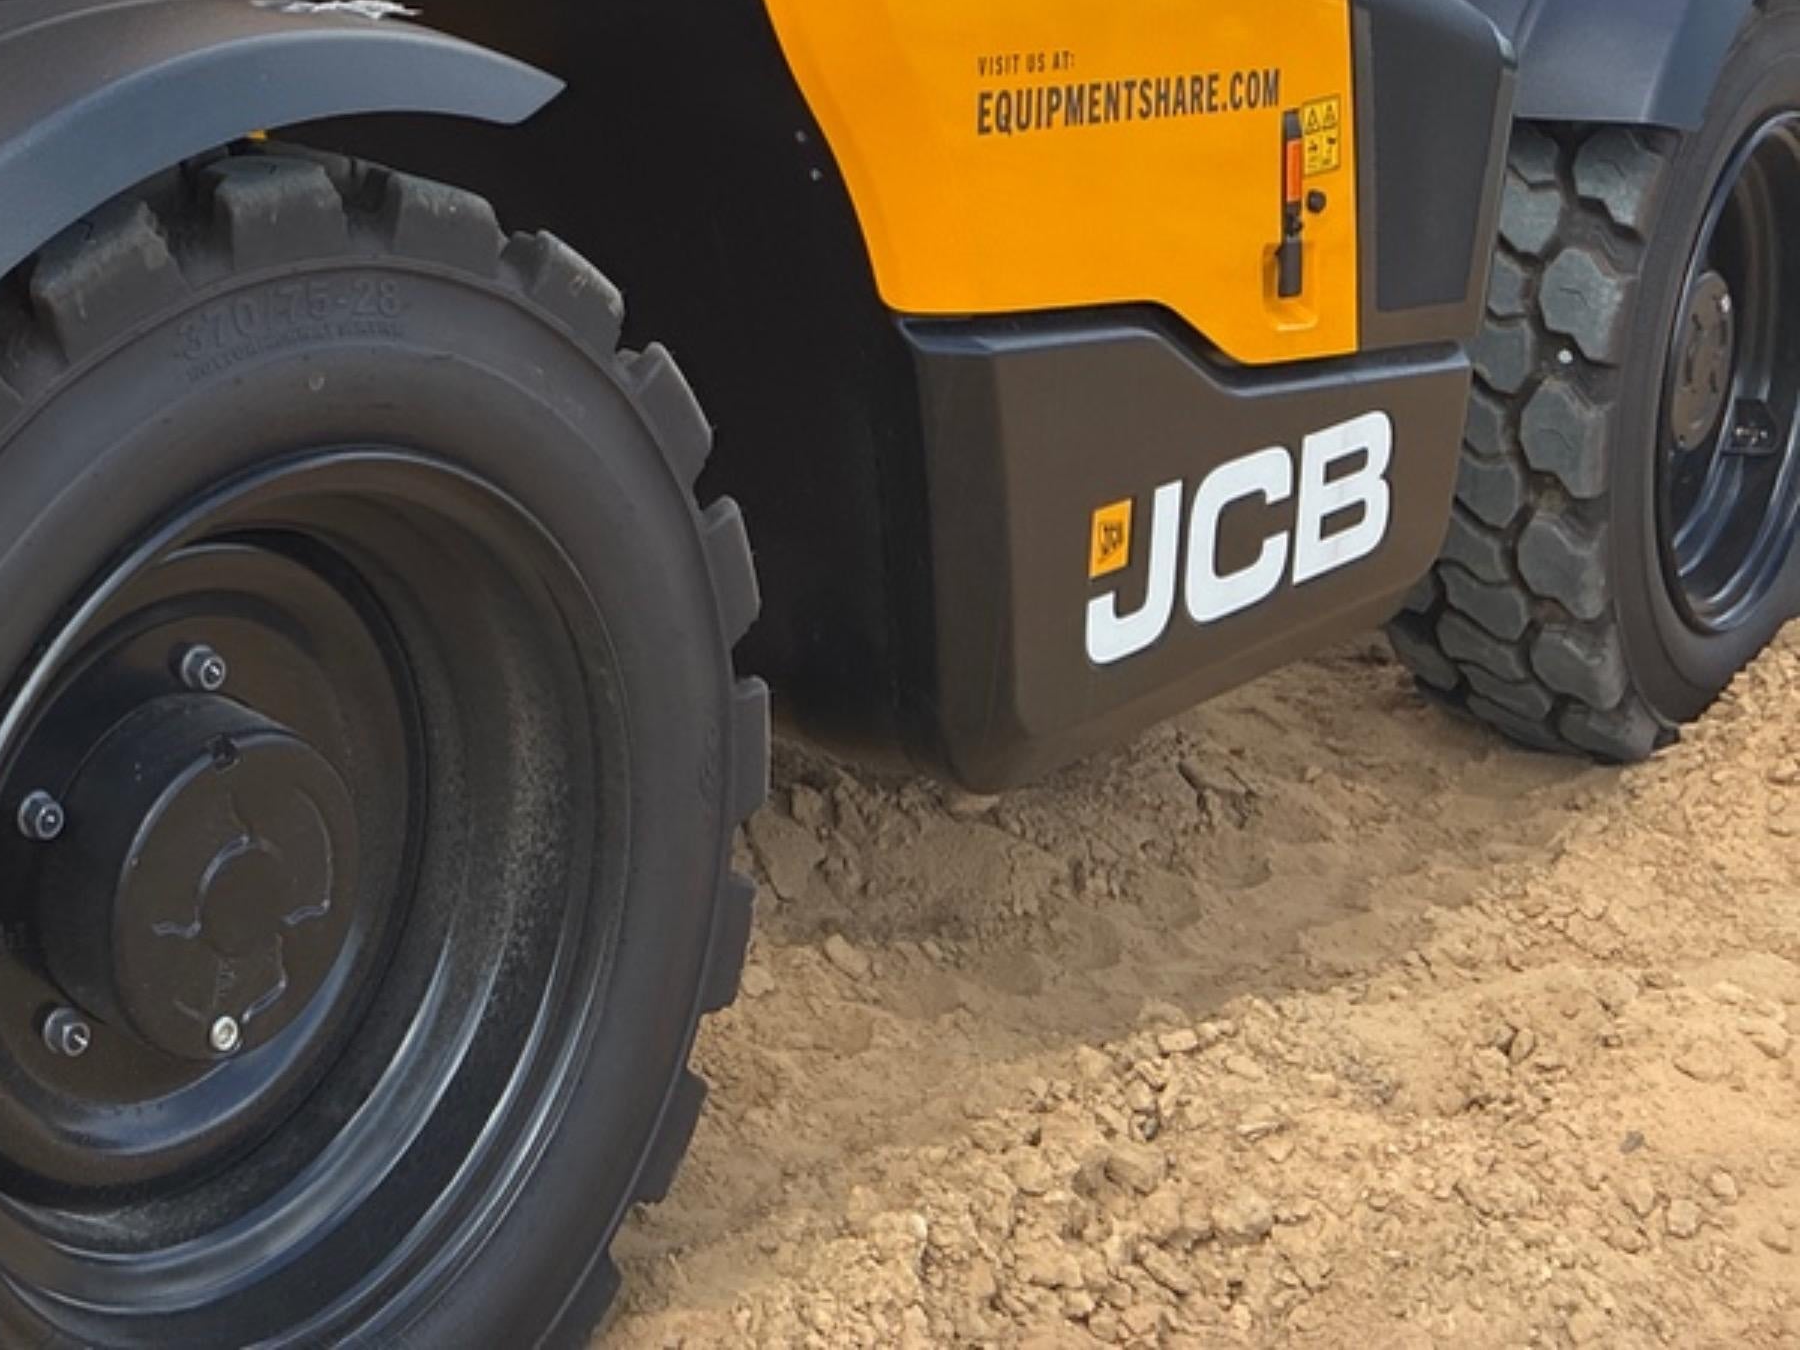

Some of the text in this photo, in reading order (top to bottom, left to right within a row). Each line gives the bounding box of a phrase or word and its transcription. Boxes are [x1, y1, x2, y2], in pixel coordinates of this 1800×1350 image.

[977, 50, 1075, 77] VISIT US AT:
[977, 68, 1281, 138] EQUIPMENTSHARE.COM
[1086, 410, 1392, 664] JCB
